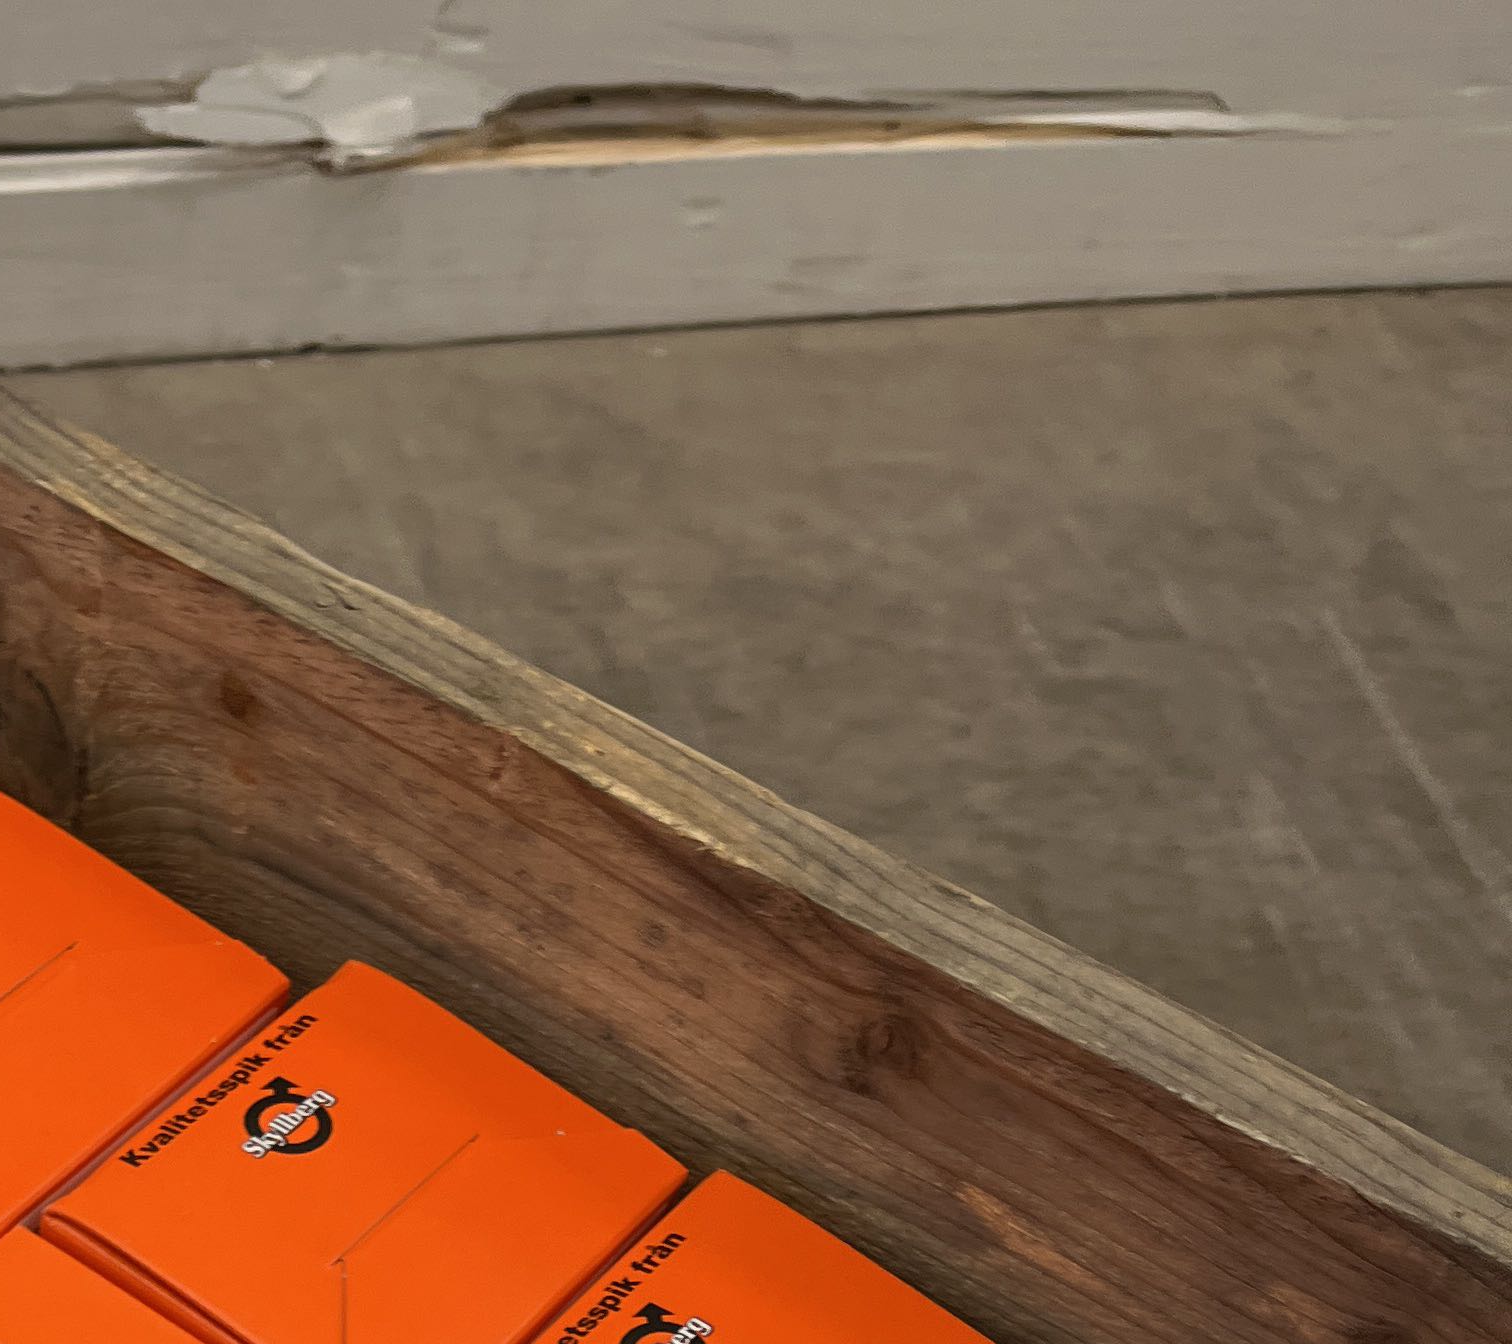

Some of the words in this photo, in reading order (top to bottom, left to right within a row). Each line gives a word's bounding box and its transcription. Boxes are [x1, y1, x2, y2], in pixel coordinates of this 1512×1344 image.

[119, 1050, 271, 1169] Kvalitetsspik
[264, 1011, 317, 1056] från
[242, 1088, 337, 1158] Skyllberg
[632, 1232, 687, 1278] från
